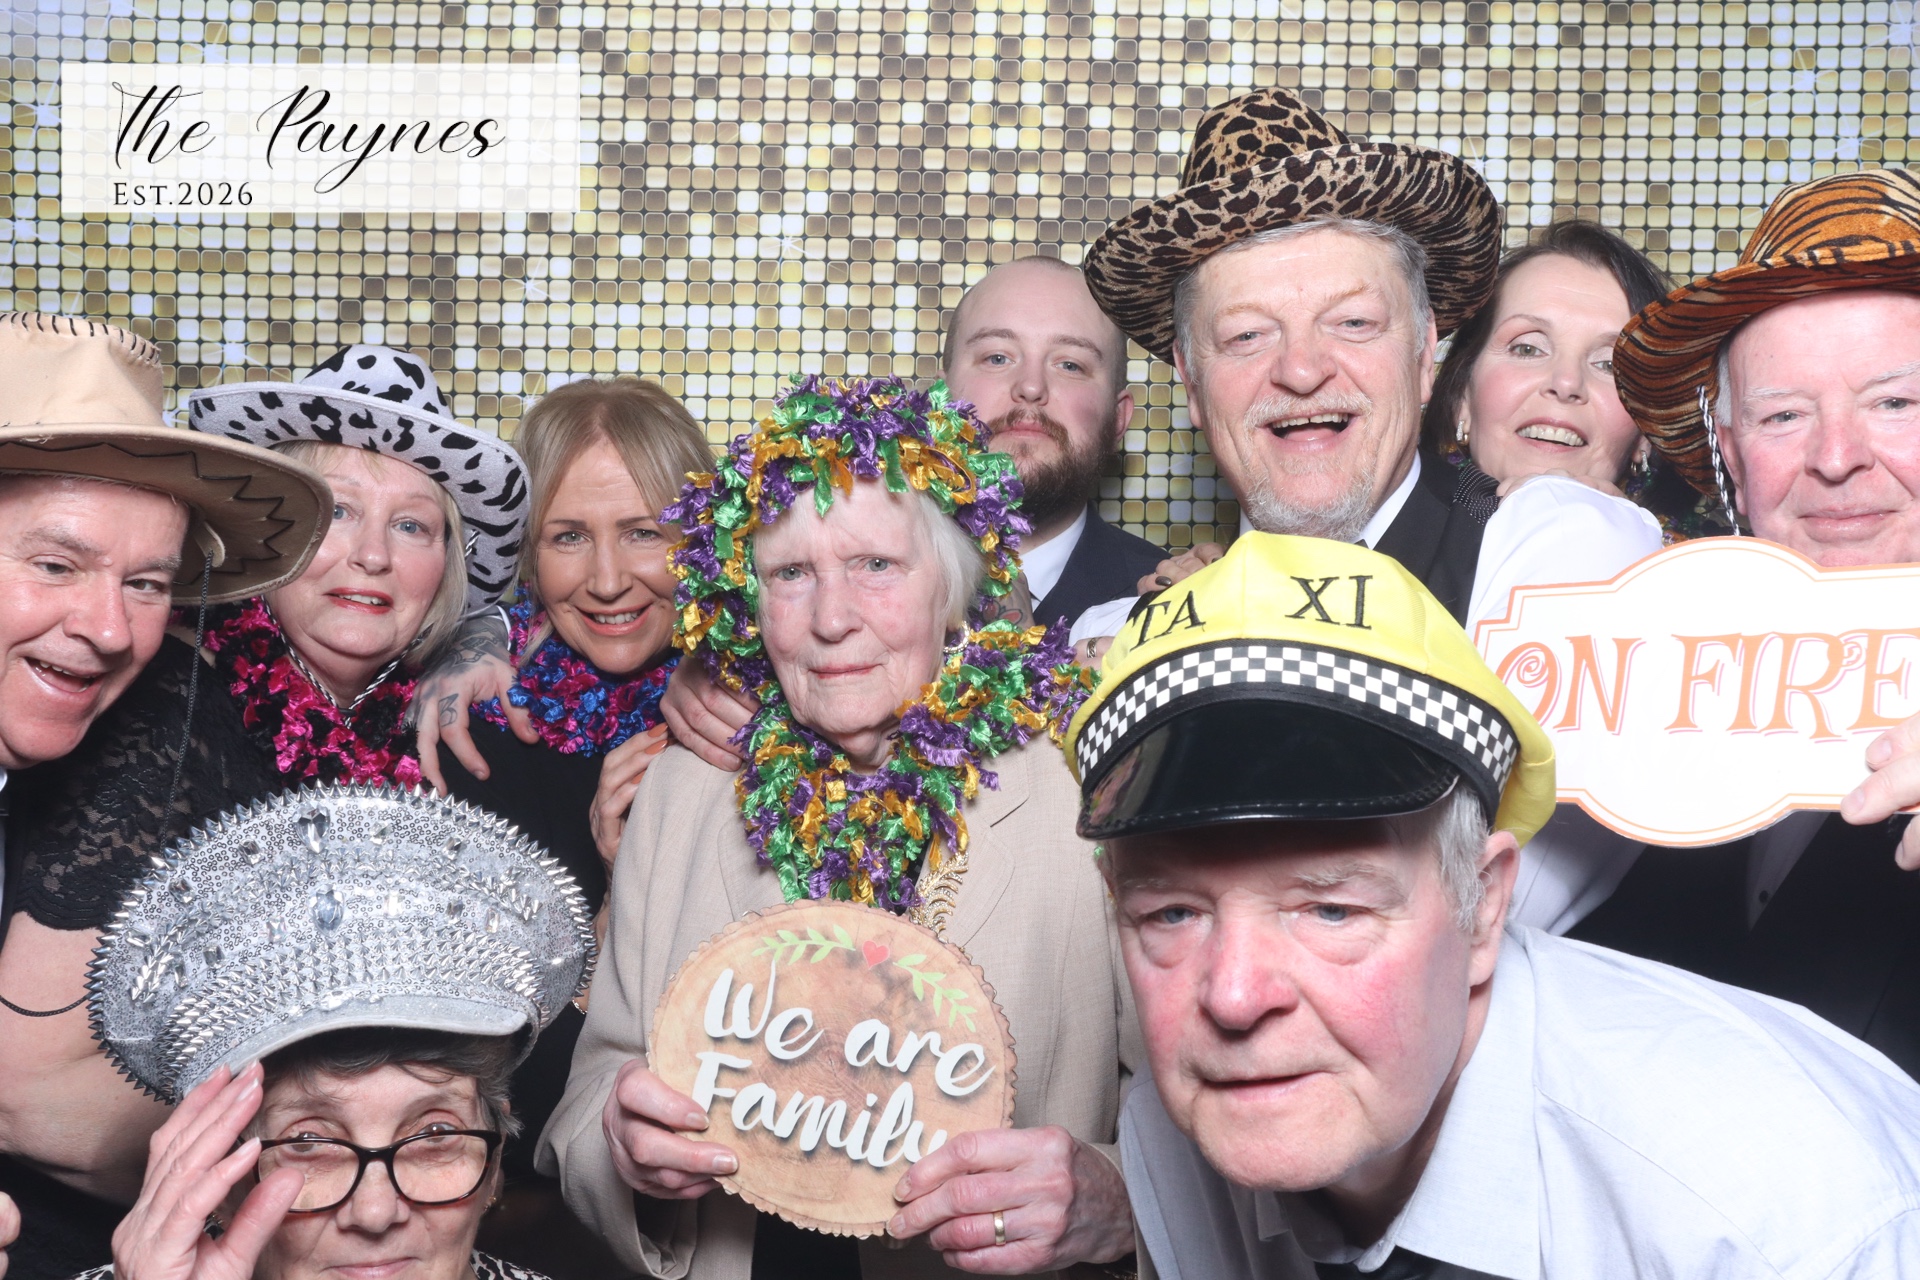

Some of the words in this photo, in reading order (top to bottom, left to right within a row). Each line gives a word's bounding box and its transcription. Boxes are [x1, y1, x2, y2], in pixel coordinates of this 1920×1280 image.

[1494, 634, 1646, 736] ON
[1664, 627, 1920, 744] FIRE
[704, 960, 825, 1060] We
[844, 1018, 996, 1096] are
